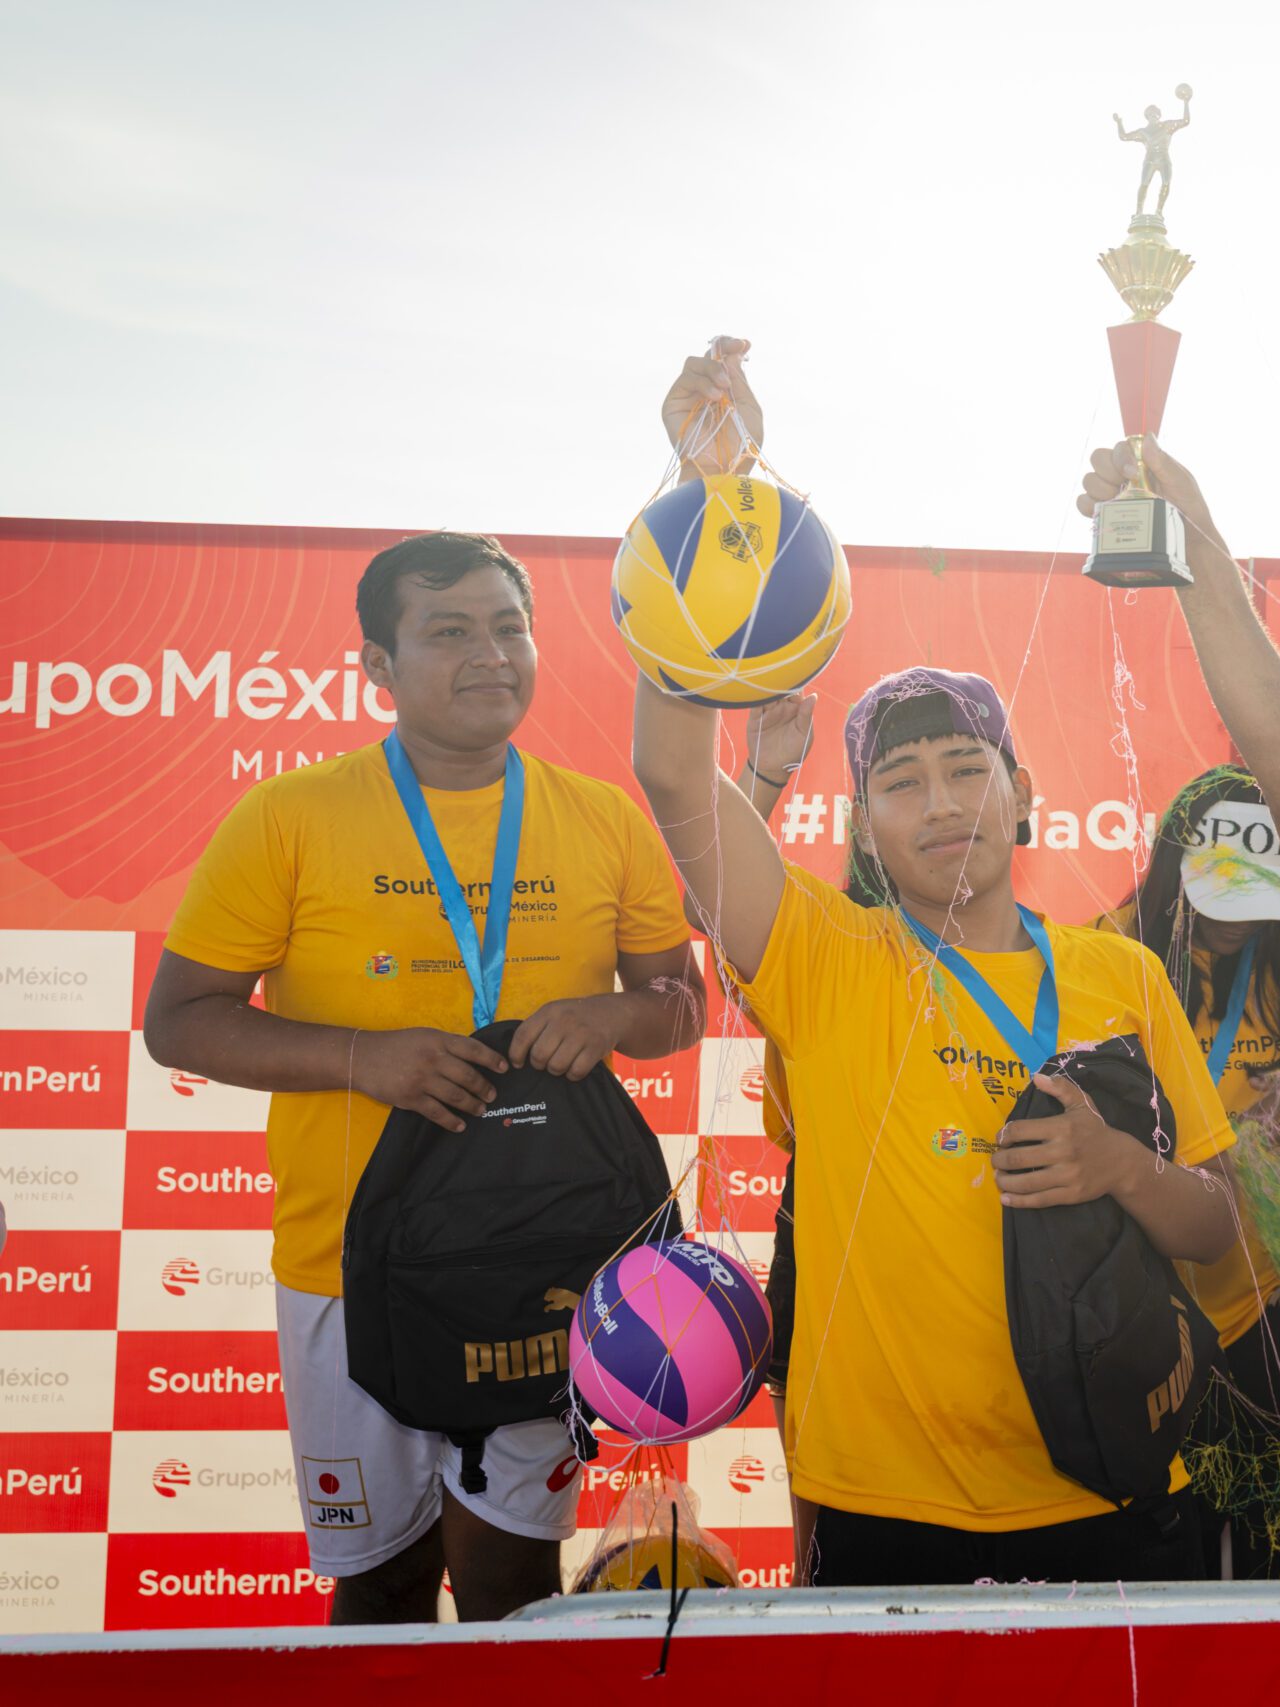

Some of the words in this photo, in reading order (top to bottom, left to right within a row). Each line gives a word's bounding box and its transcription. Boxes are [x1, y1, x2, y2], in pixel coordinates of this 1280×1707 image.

[0, 965, 88, 986] México
[156, 1166, 277, 1193] Southe
[317, 1507, 354, 1523] JPN
